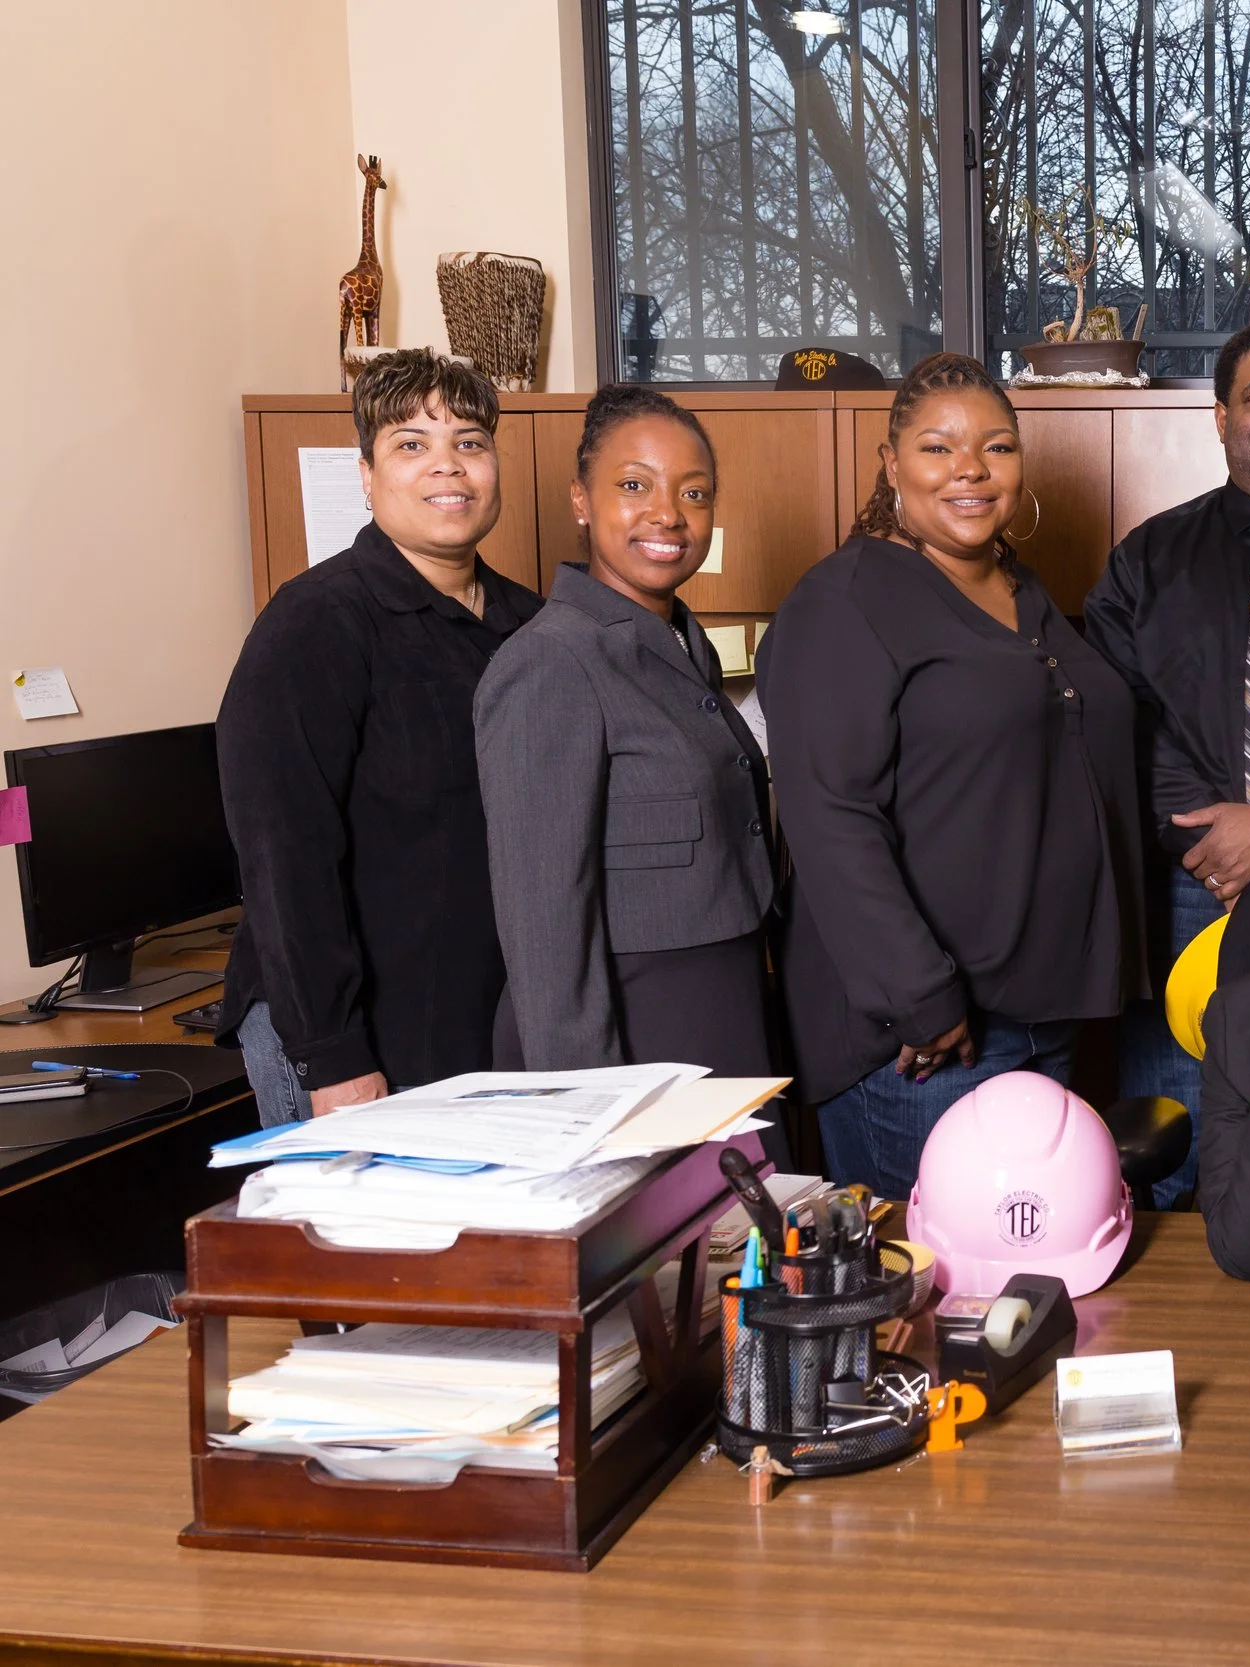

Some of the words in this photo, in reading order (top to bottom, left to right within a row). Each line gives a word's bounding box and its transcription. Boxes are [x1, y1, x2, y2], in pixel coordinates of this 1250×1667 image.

[994, 1194, 1012, 1216] TAYLOR
[1014, 1190, 1045, 1203] ELECTRIC
[1006, 1202, 1040, 1237] TEC
